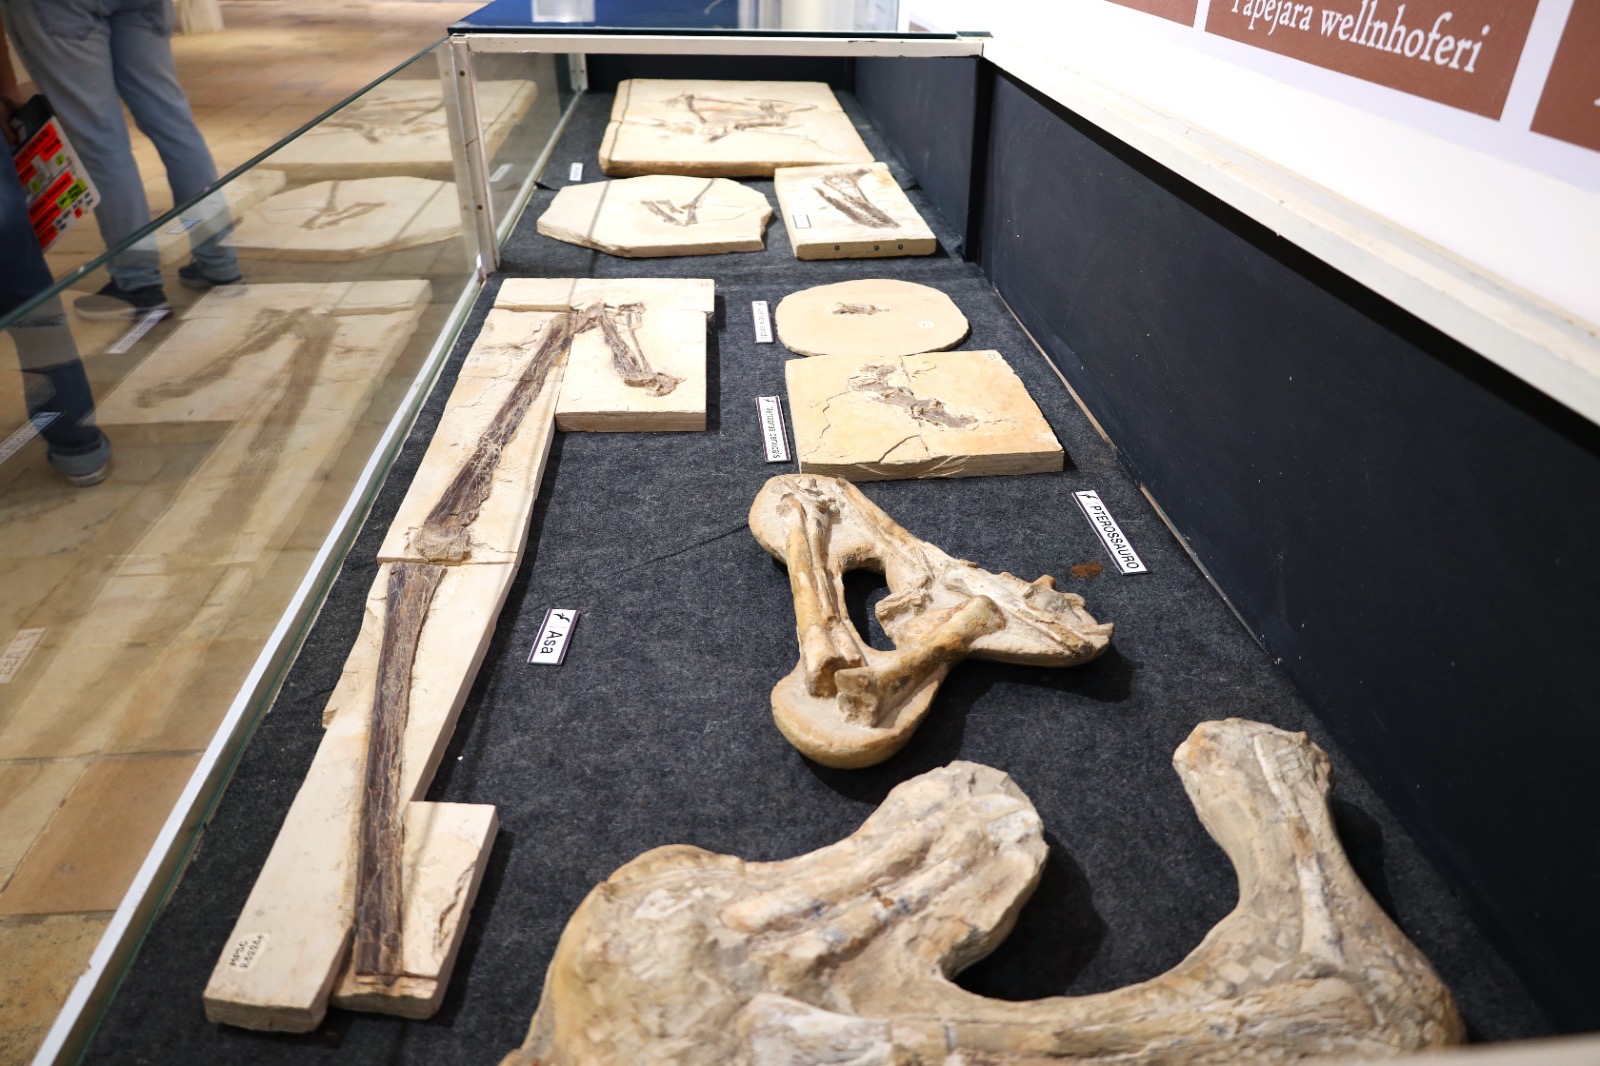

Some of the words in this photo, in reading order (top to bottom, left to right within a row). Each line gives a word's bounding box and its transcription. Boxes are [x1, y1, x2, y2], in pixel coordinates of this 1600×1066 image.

[1320, 0, 1491, 73] wellnhoferi
[1090, 505, 1140, 570] PTEROSSAURO
[540, 630, 563, 654] Asa
